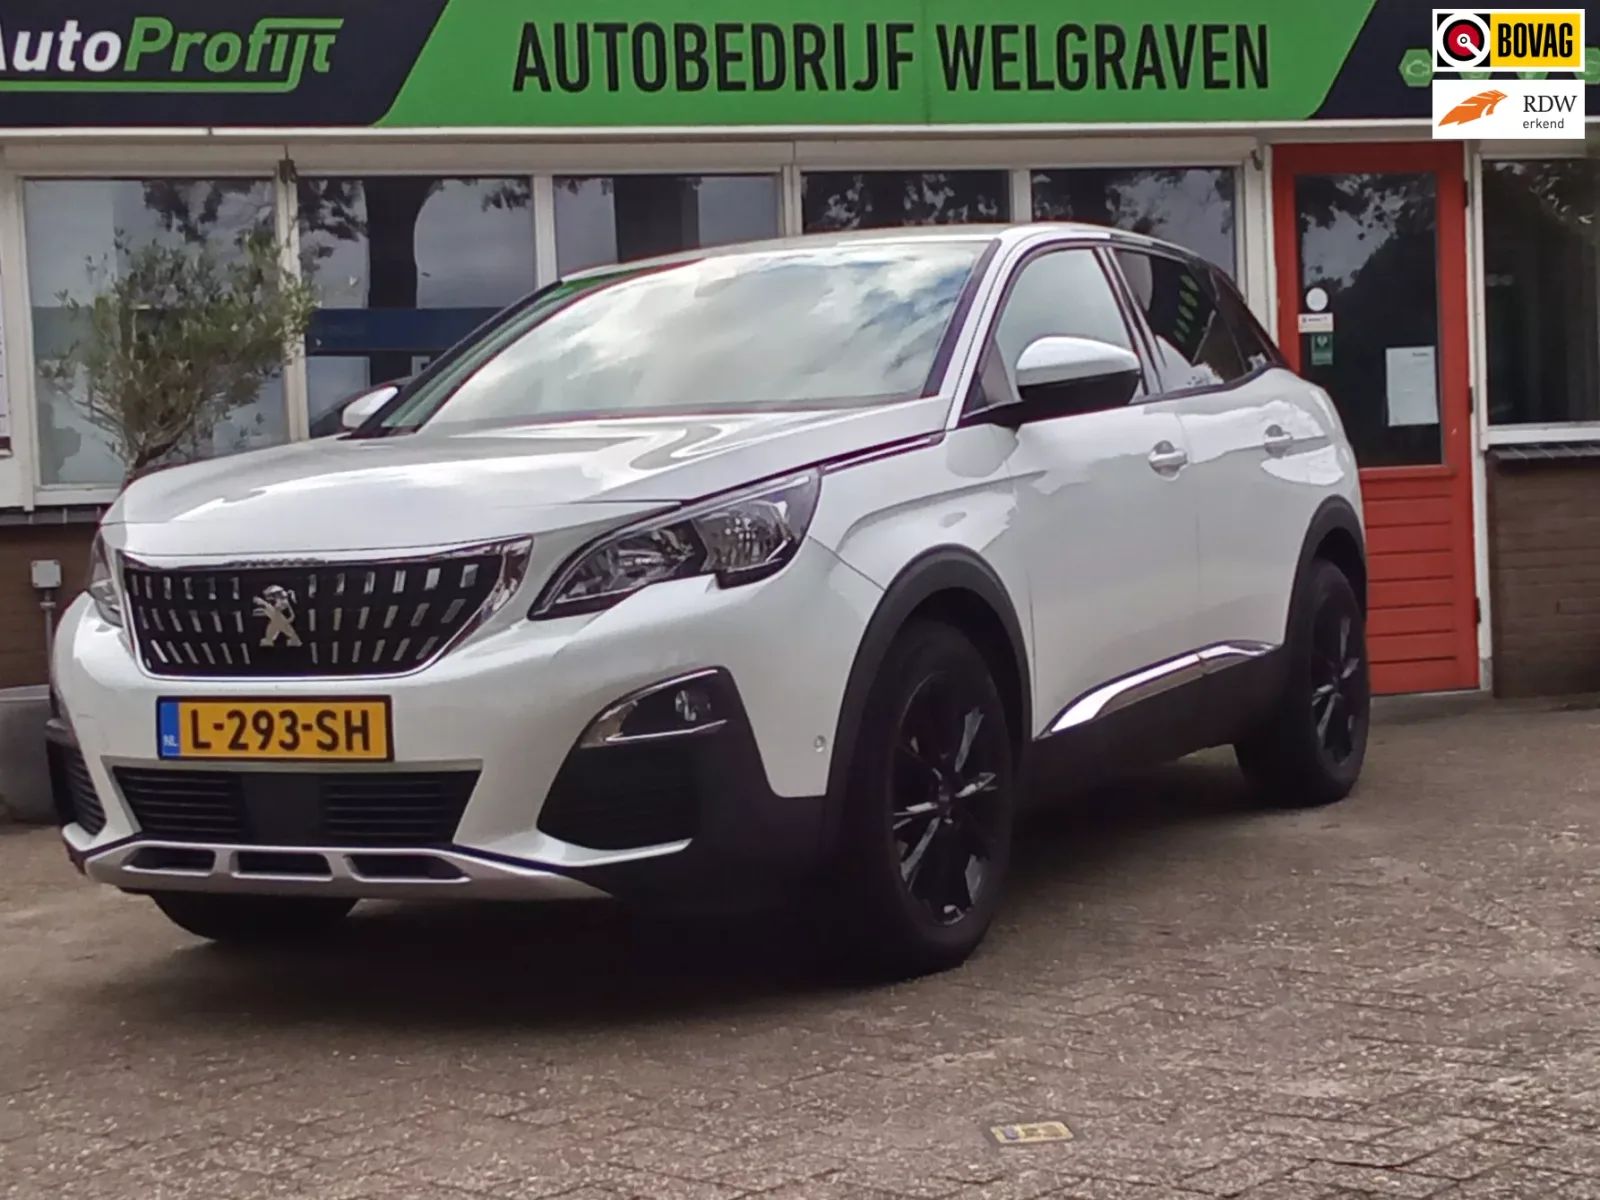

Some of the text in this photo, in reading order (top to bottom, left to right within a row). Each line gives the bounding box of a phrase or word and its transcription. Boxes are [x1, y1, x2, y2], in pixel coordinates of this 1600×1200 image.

[0, 16, 344, 93] utoProfijt
[513, 21, 1269, 93] AUTOBEDRIJF WELGRAVEN
[163, 735, 178, 747] NL
[191, 709, 370, 751] L-293-SH
